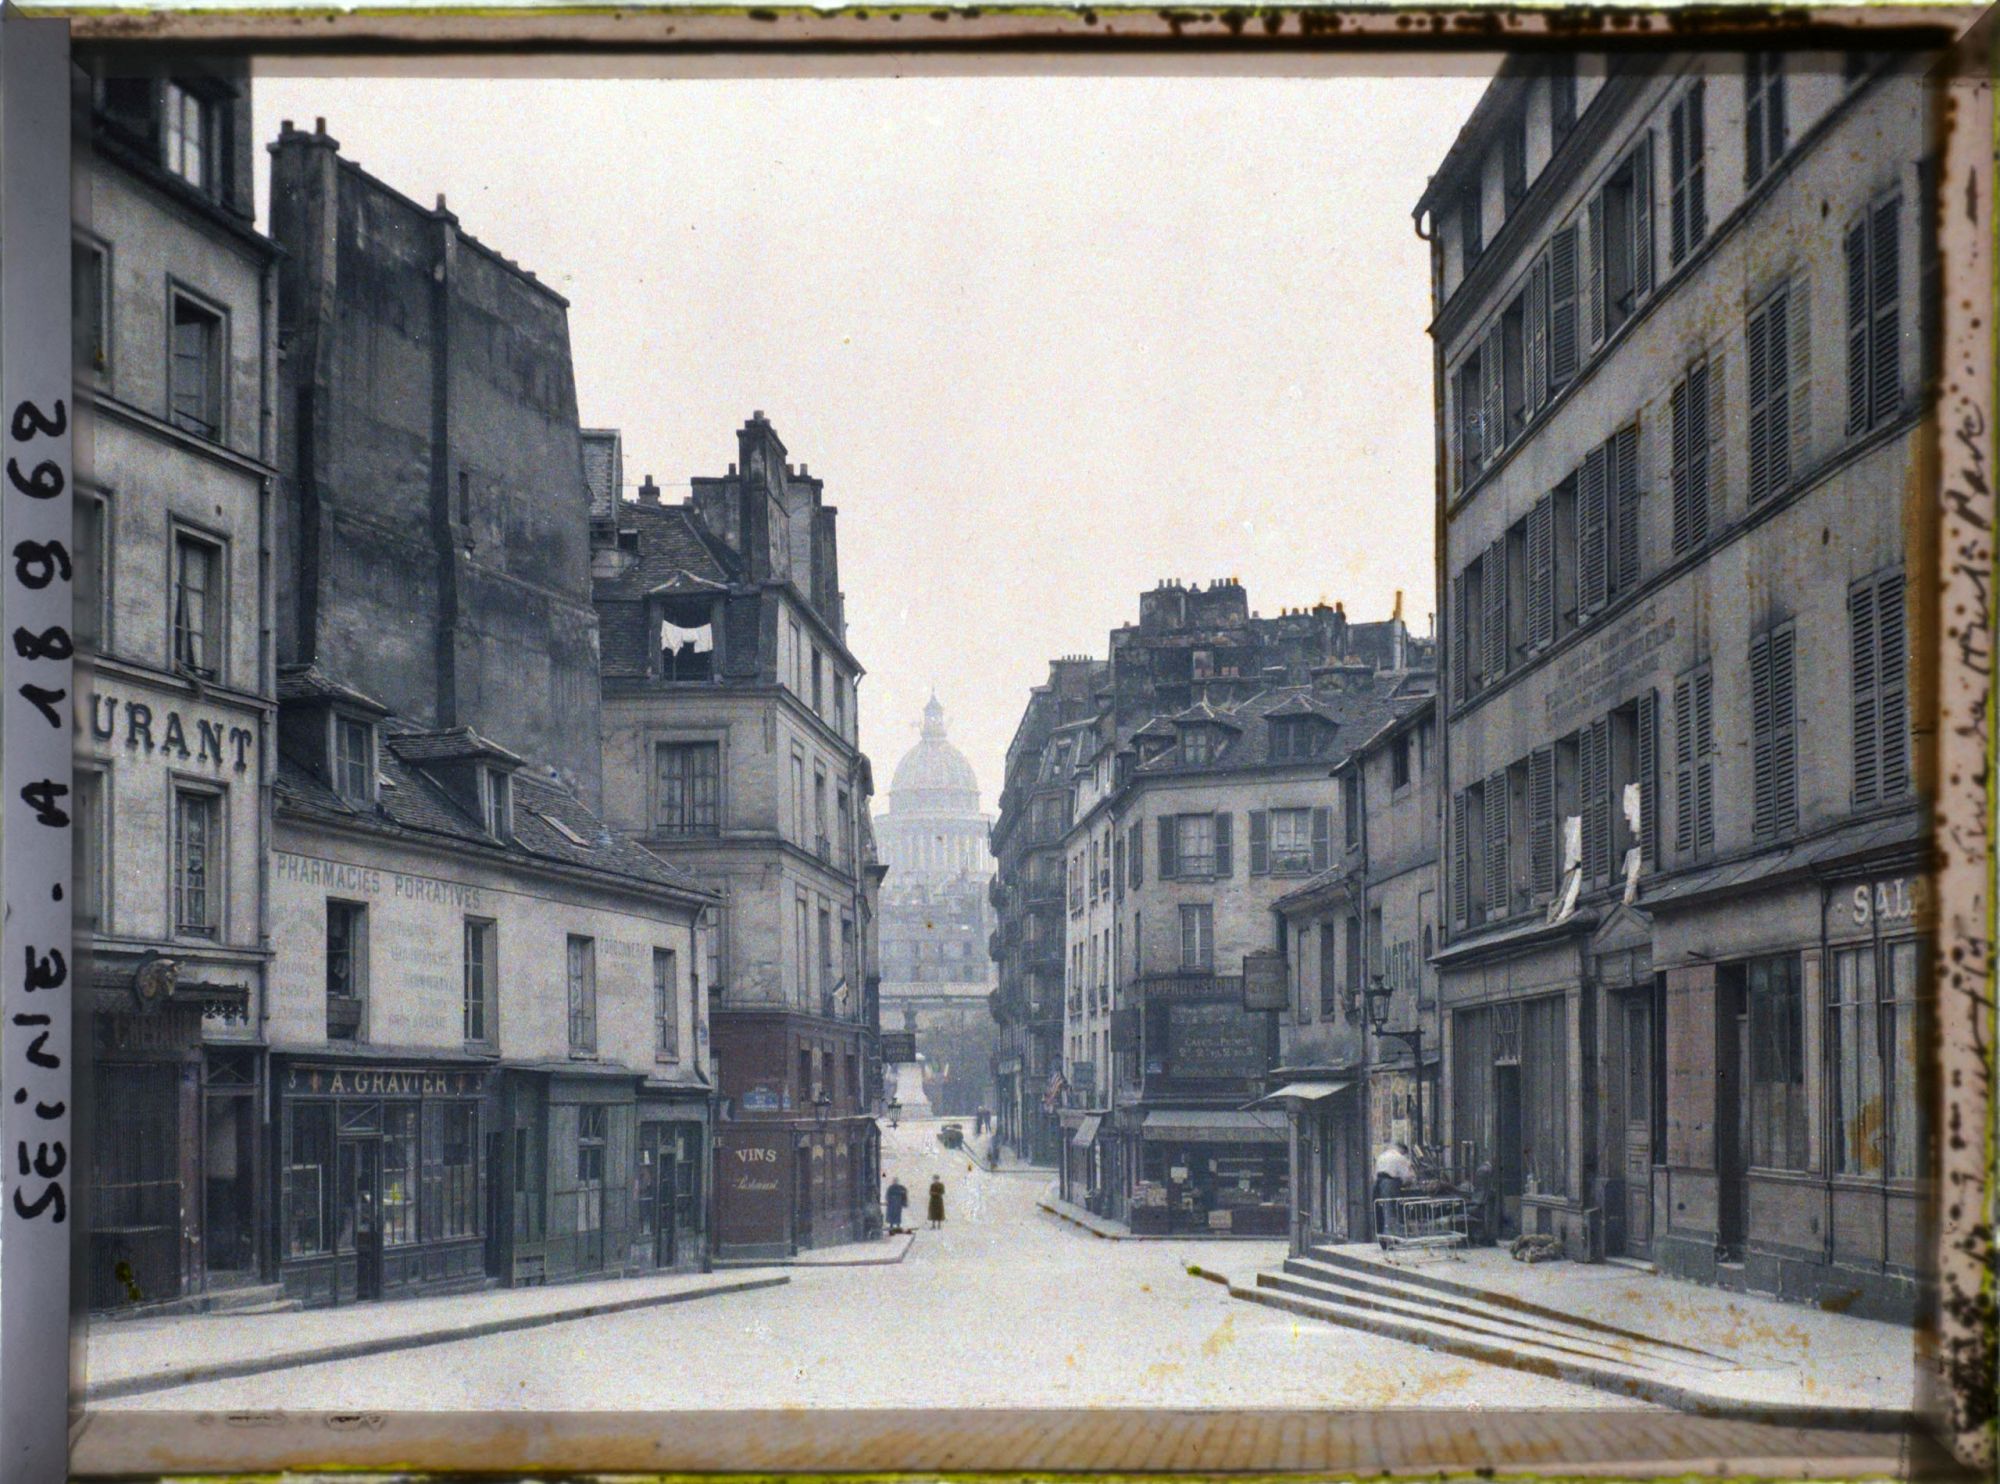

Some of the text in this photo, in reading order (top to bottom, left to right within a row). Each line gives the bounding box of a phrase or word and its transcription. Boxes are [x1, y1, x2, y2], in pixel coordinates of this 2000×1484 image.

[276, 854, 481, 909] PHARMACIES PORTATIVES
[735, 1147, 777, 1164] VINS
